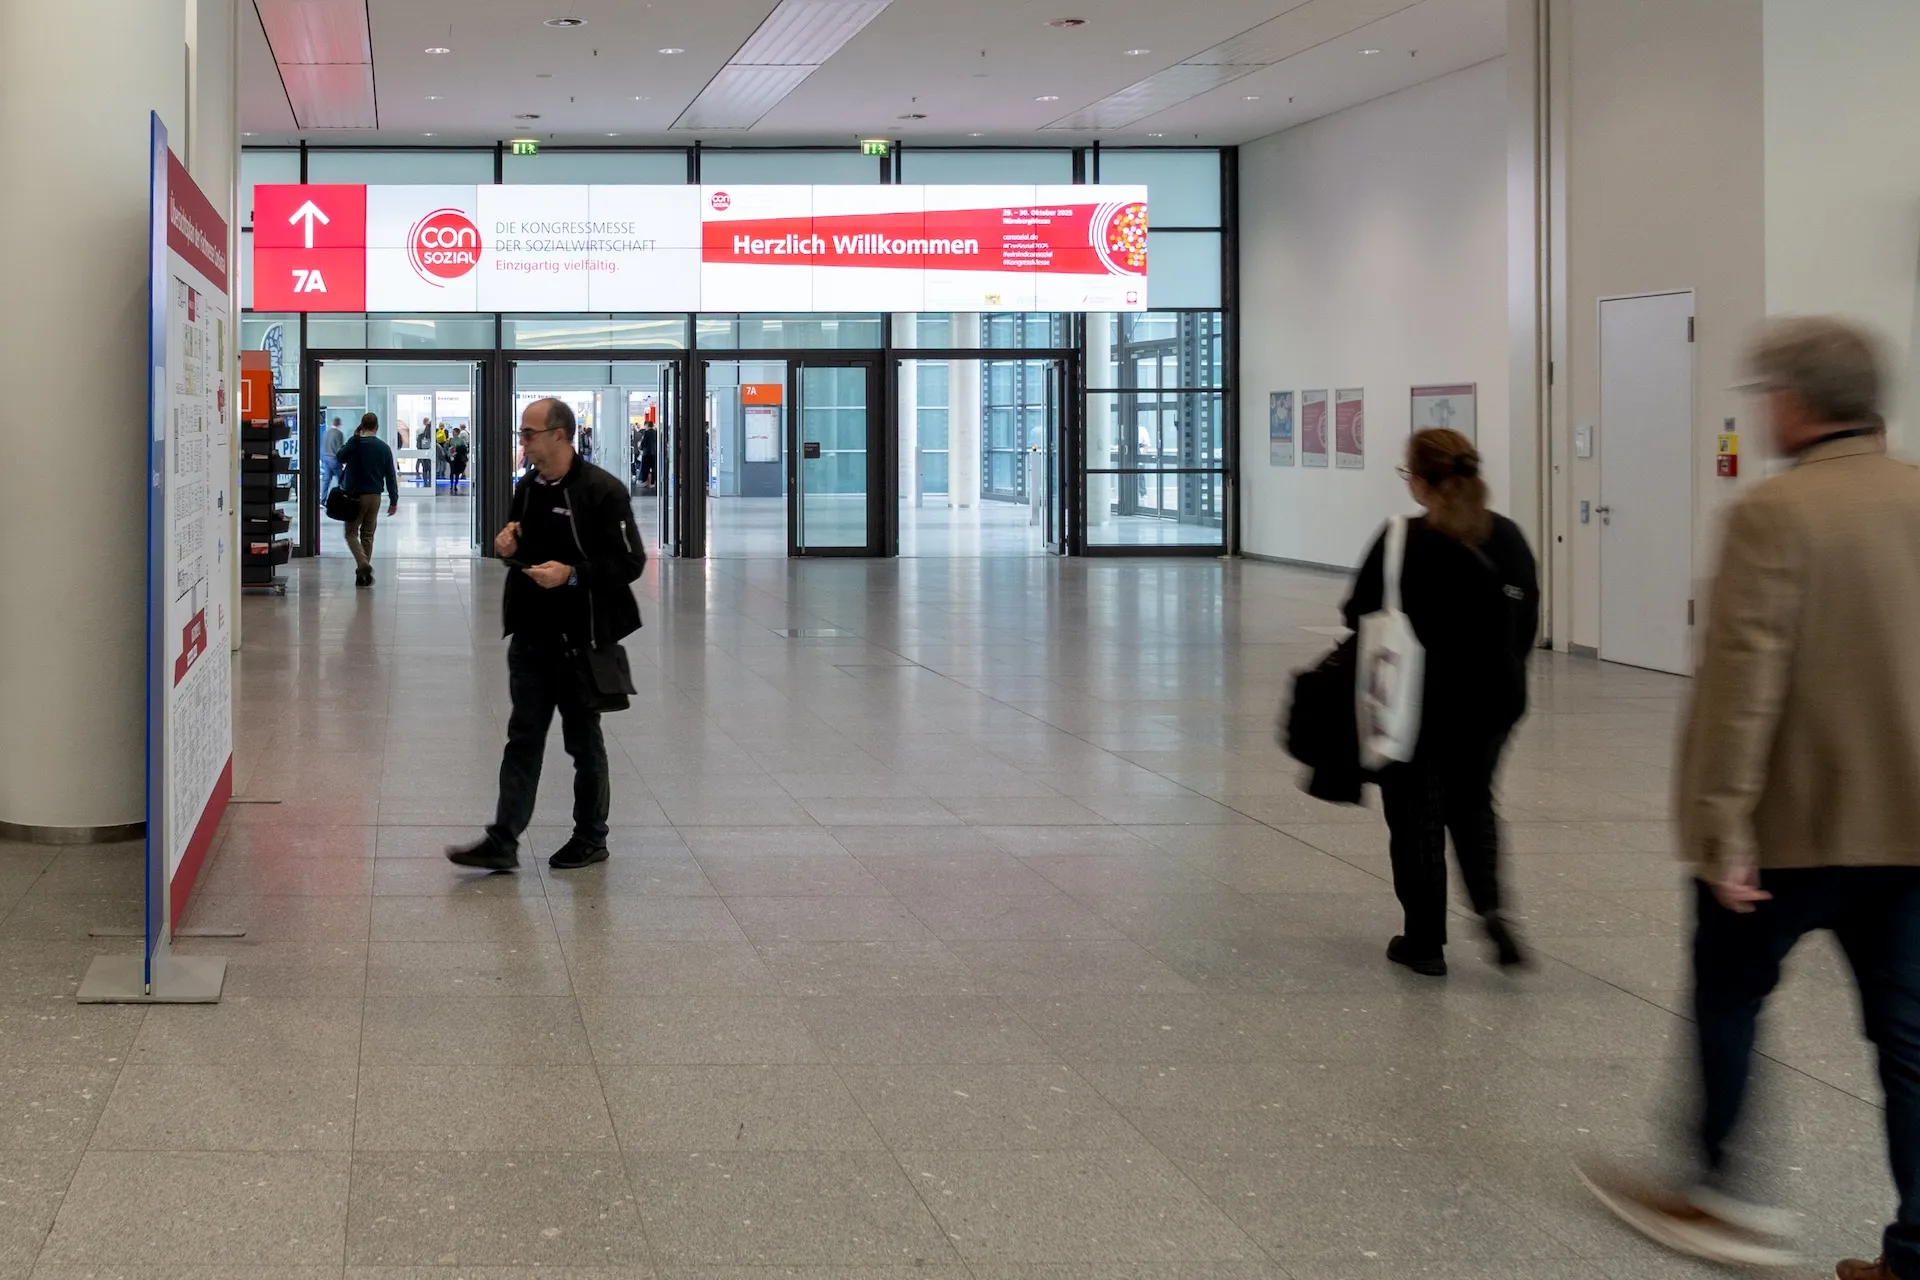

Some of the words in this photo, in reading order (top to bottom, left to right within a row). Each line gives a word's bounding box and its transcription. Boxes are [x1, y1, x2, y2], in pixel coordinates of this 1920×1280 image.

[1030, 209, 1056, 217] Oktober
[495, 222, 516, 234] DIE
[521, 222, 636, 234] KONGRESSMESSE
[495, 239, 521, 252] DER
[525, 239, 656, 252] SOZIALWIRTSCHAFT
[733, 234, 826, 256] Herzlich
[832, 234, 979, 256] Willkommen
[423, 250, 477, 265] SOZIAL
[495, 259, 560, 273] Einzigartig
[563, 258, 620, 273] vielfältig.
[291, 269, 328, 294] 7A
[746, 386, 757, 396] 7A
